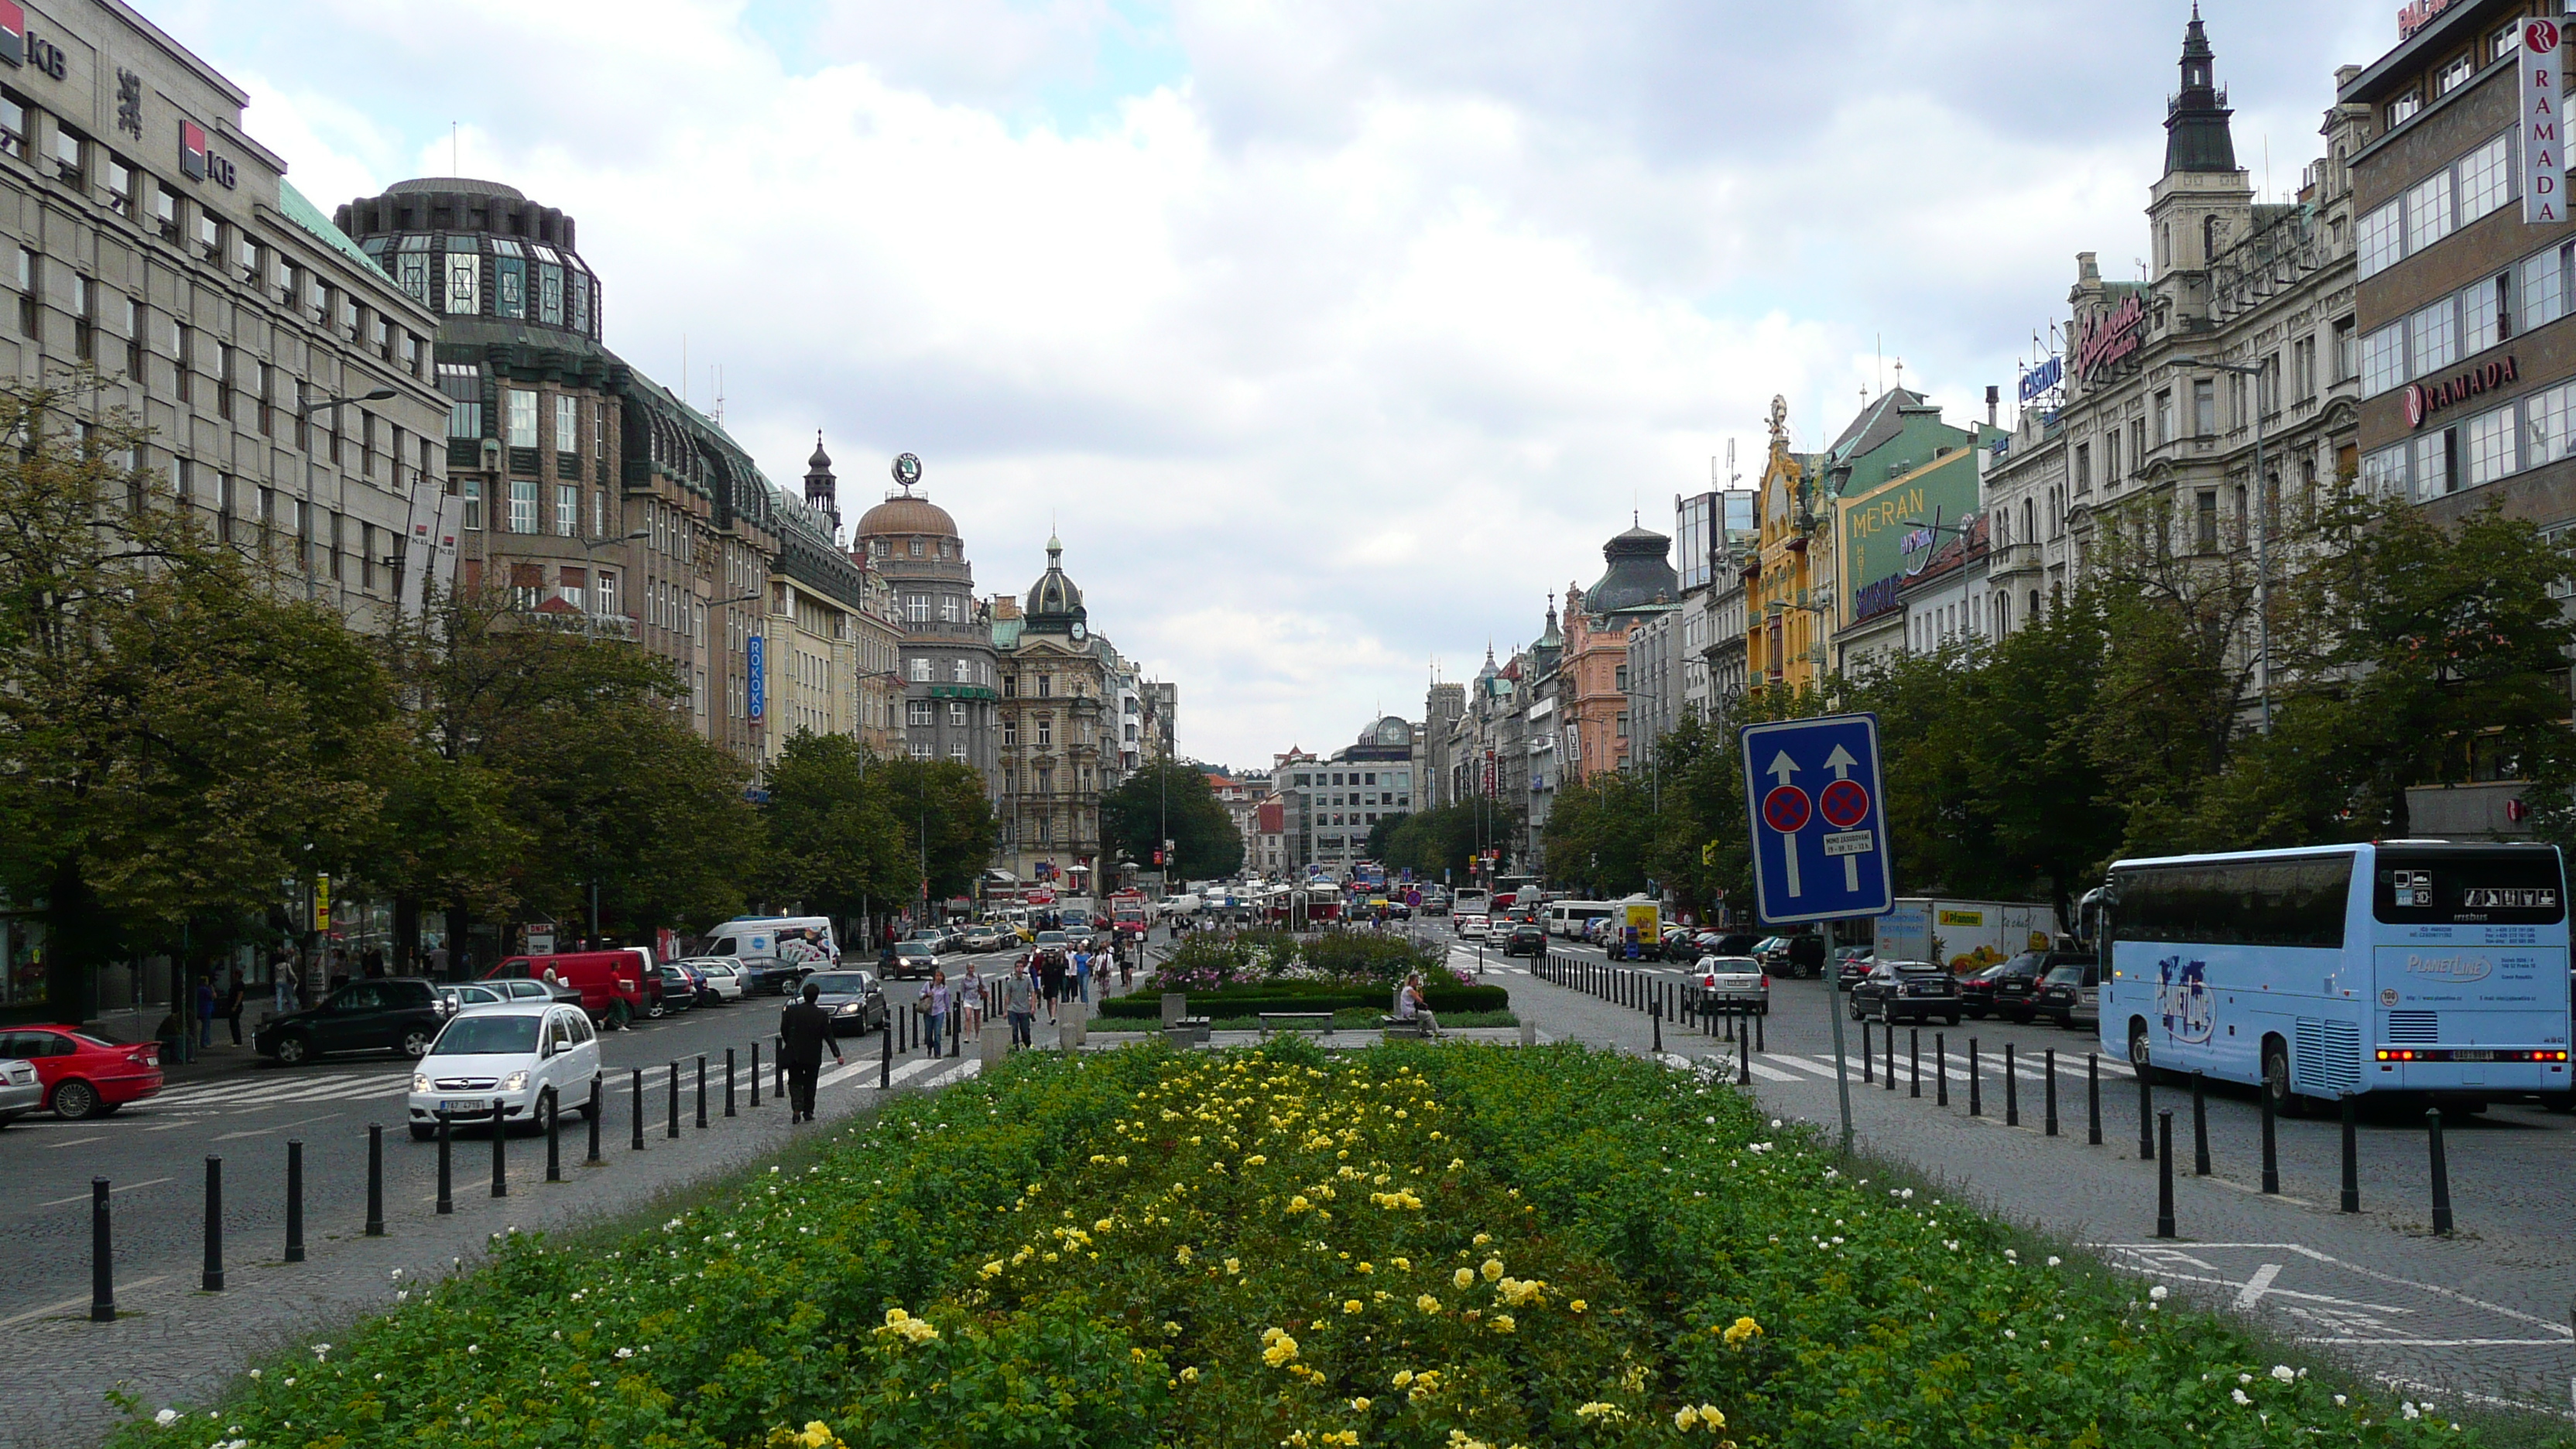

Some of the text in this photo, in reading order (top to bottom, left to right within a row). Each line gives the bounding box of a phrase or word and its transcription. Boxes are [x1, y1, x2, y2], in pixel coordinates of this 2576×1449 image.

[27, 31, 67, 80] KB
[207, 149, 238, 190] KB
[2533, 70, 2554, 221] RAMADA
[2078, 289, 2143, 378] Budweiser
[2019, 356, 2061, 401] CASINO
[2427, 355, 2515, 411] RAMADA
[1853, 488, 1923, 538] MERAN
[412, 537, 428, 546] KB
[751, 642, 761, 717] ROKOKO
[1950, 912, 1979, 925] Pfanner
[2382, 992, 2396, 1000] 100
